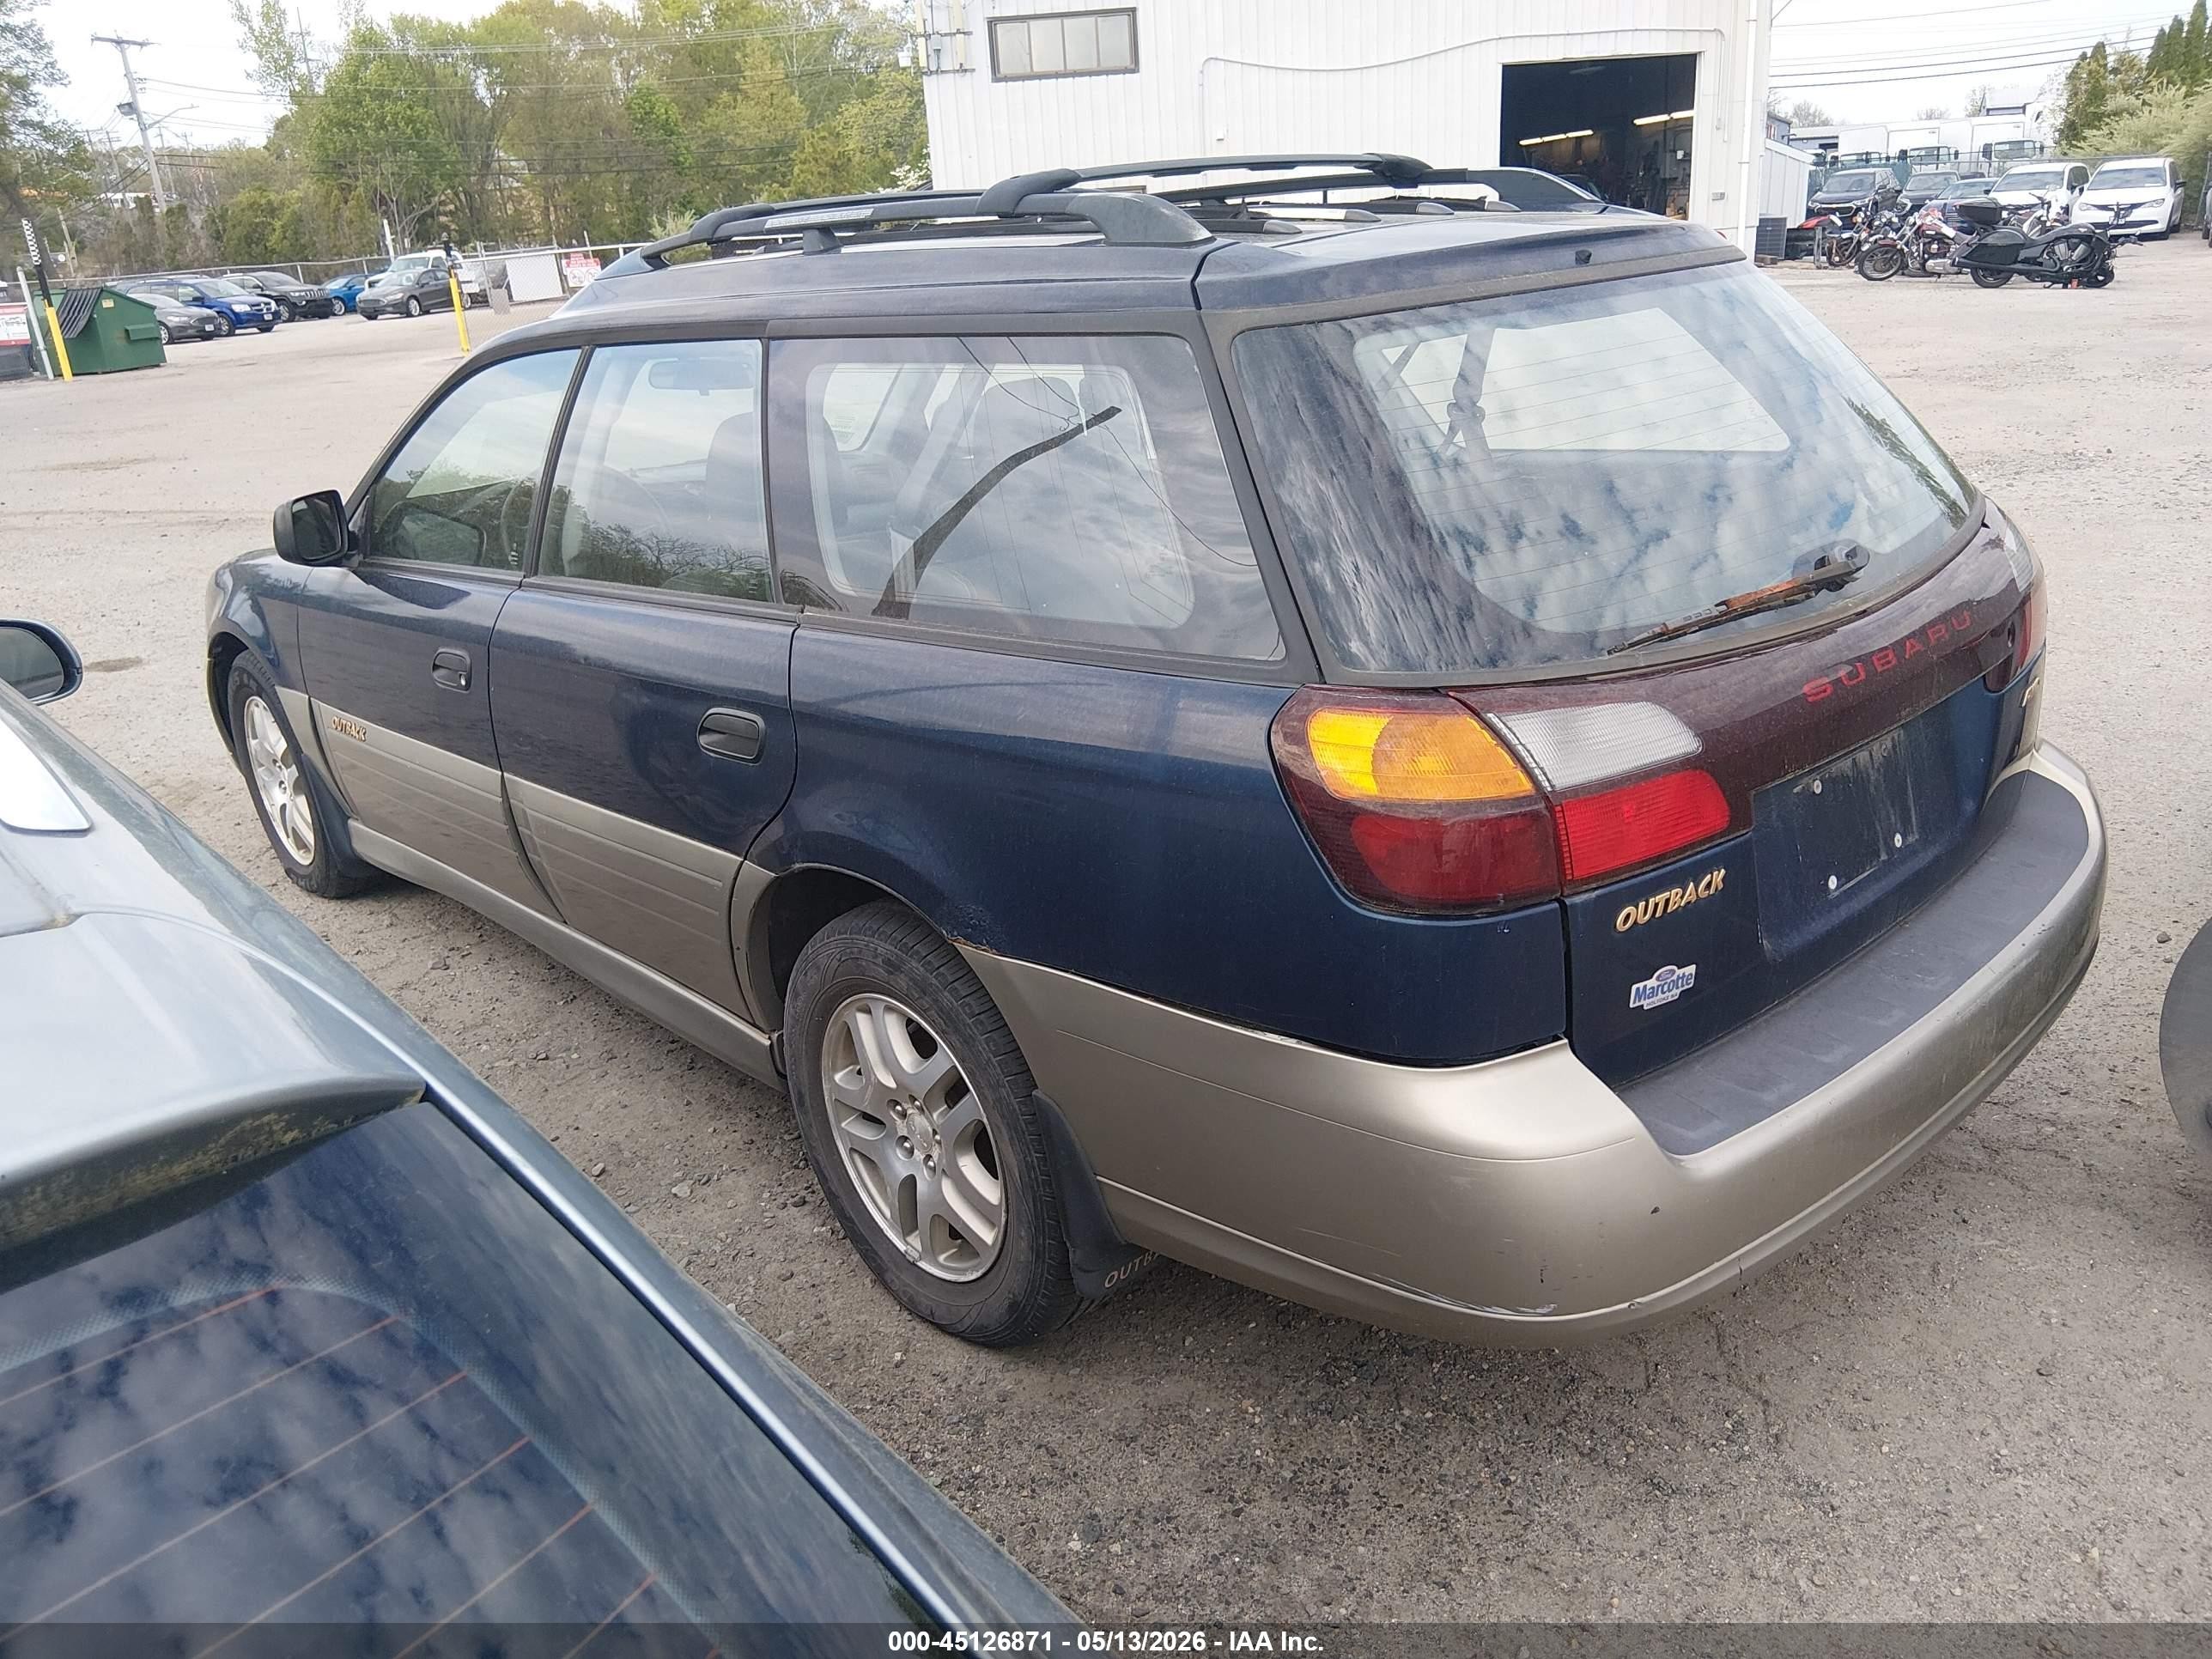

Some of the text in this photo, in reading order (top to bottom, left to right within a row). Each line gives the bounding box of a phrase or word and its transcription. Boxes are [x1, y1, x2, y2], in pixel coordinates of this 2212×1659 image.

[1802, 610, 1972, 703] SUBARU
[331, 715, 367, 742] OUTBACK
[1615, 867, 1726, 933] OUTBACK
[1632, 971, 1693, 1006] Marcotte
